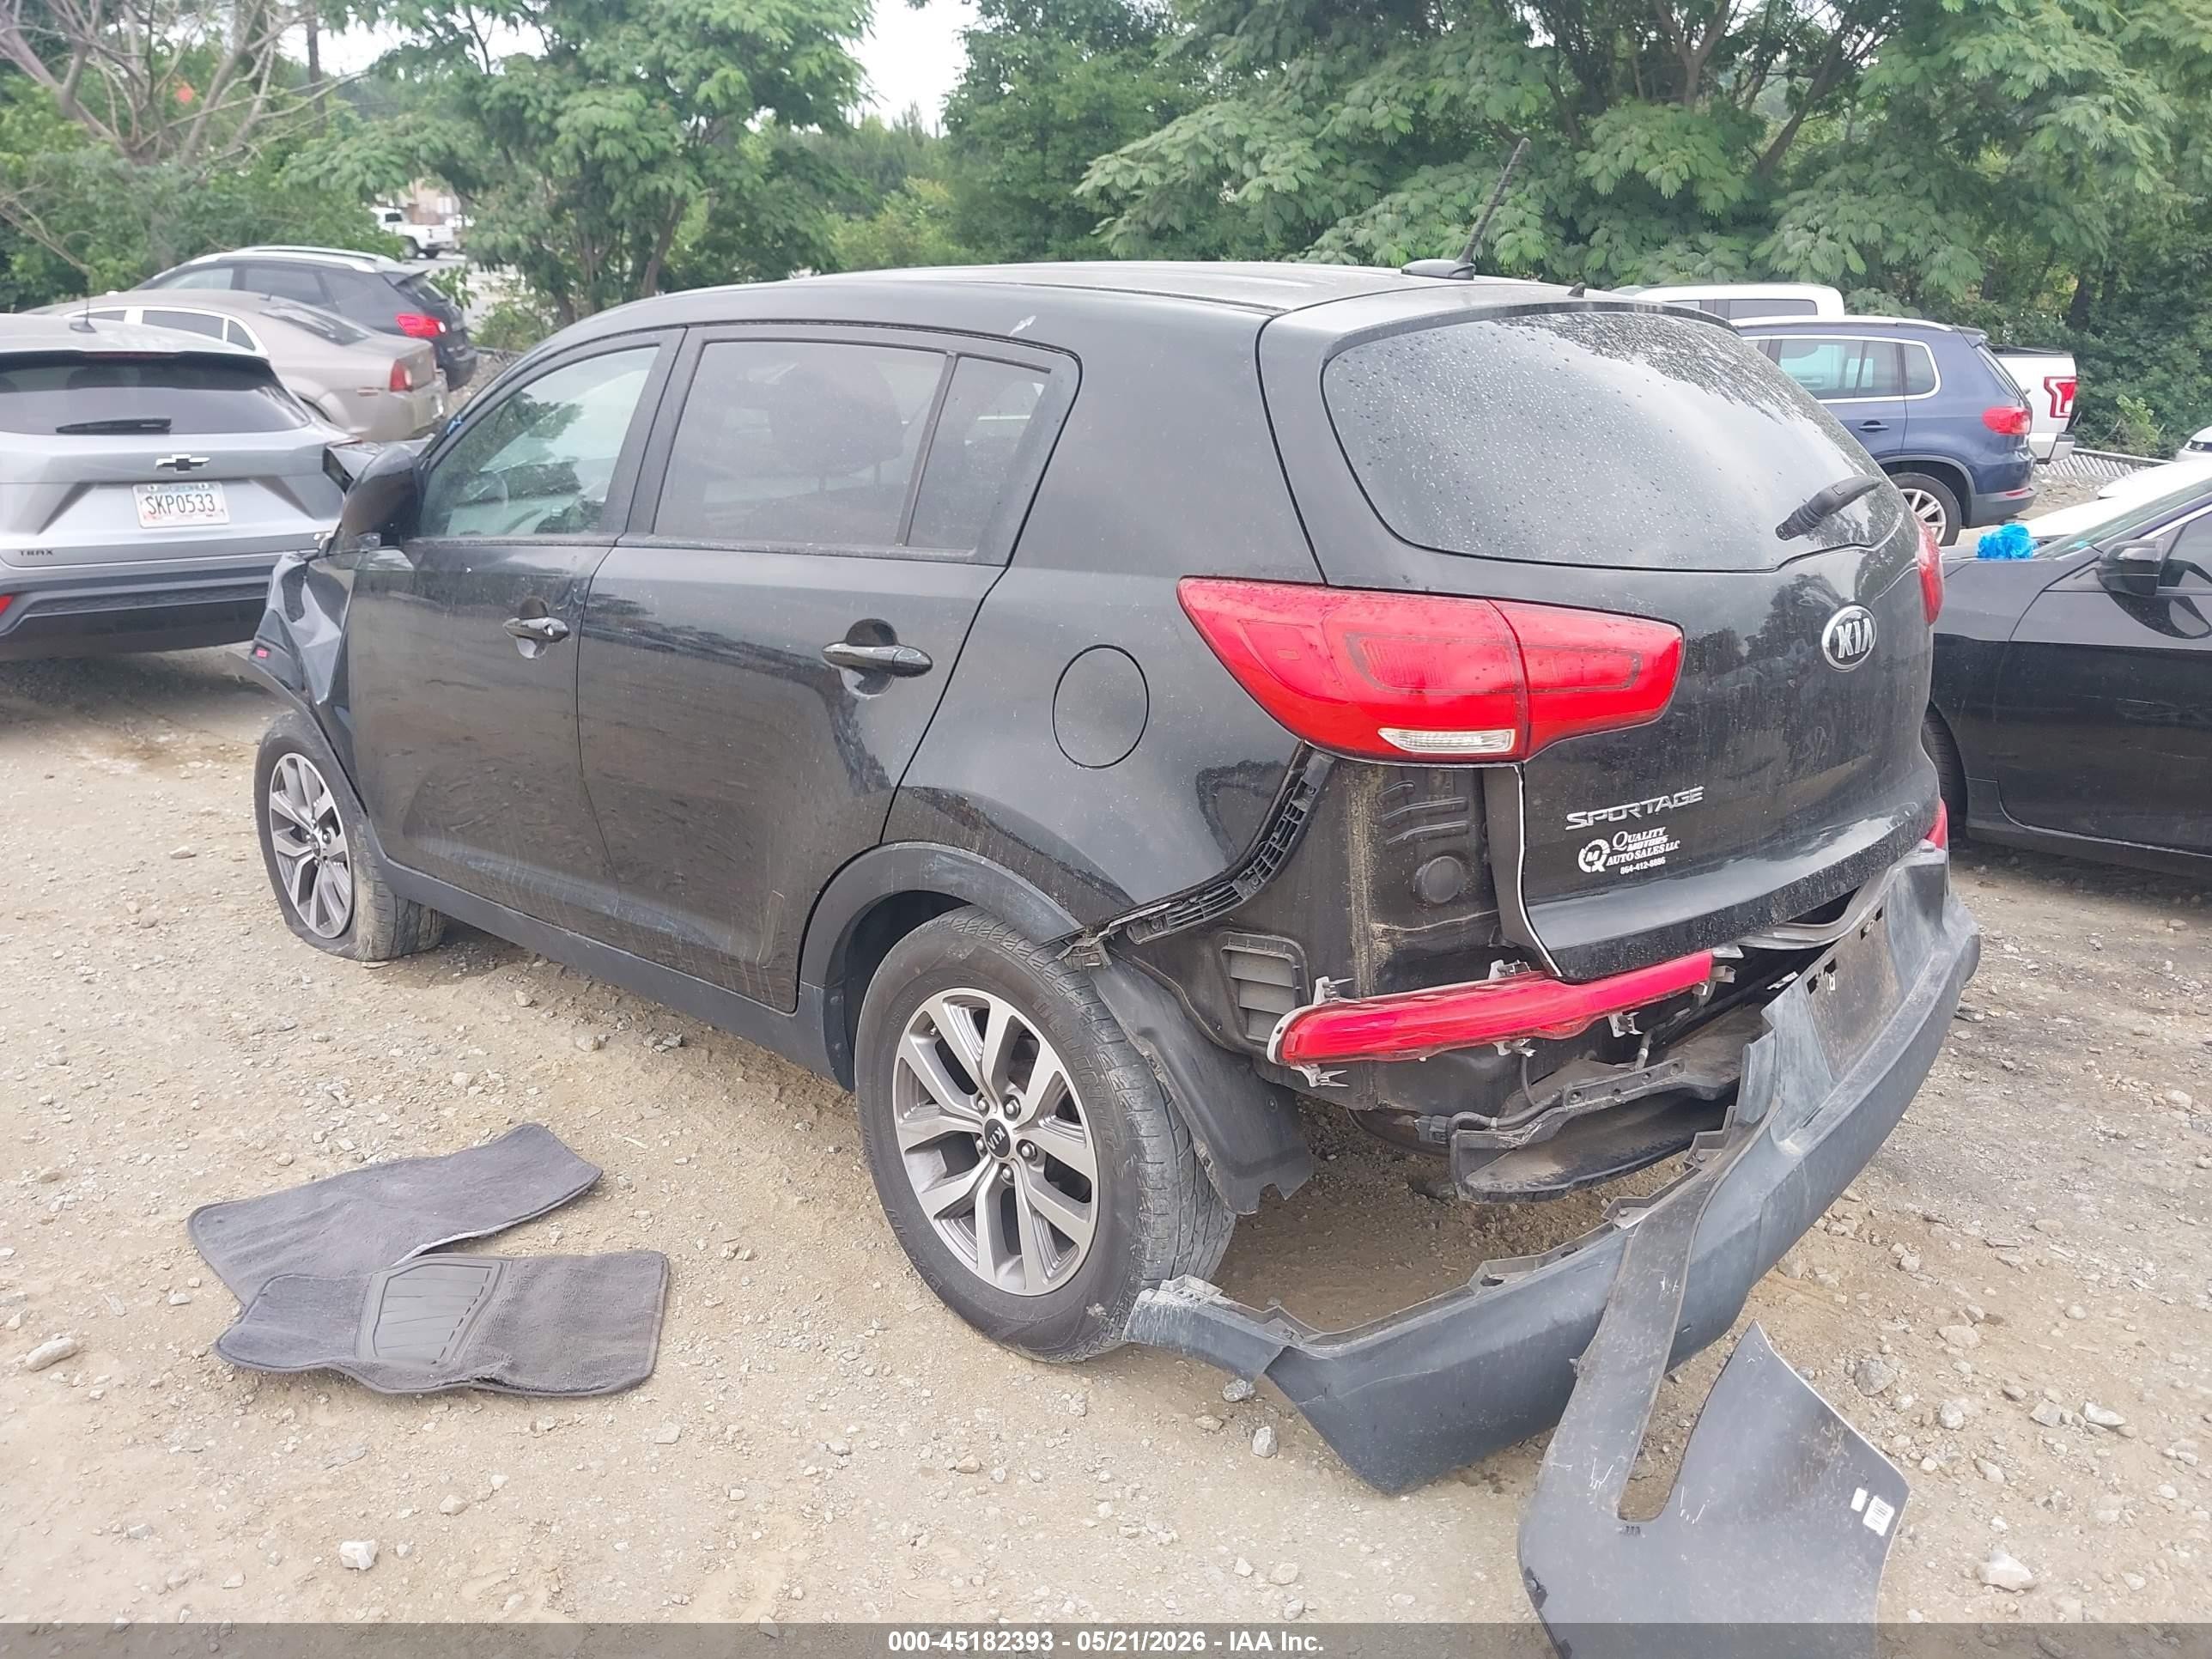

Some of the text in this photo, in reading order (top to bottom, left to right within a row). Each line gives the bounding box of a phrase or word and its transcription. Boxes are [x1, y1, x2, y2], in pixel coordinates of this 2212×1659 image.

[145, 494, 216, 515] SKP0533
[1836, 617, 1873, 659] KIA
[1565, 786, 1705, 830] SPORTAGE
[1612, 827, 1666, 851] QUALITY
[1606, 851, 1635, 866] AUTO
[1634, 843, 1666, 860] SALES
